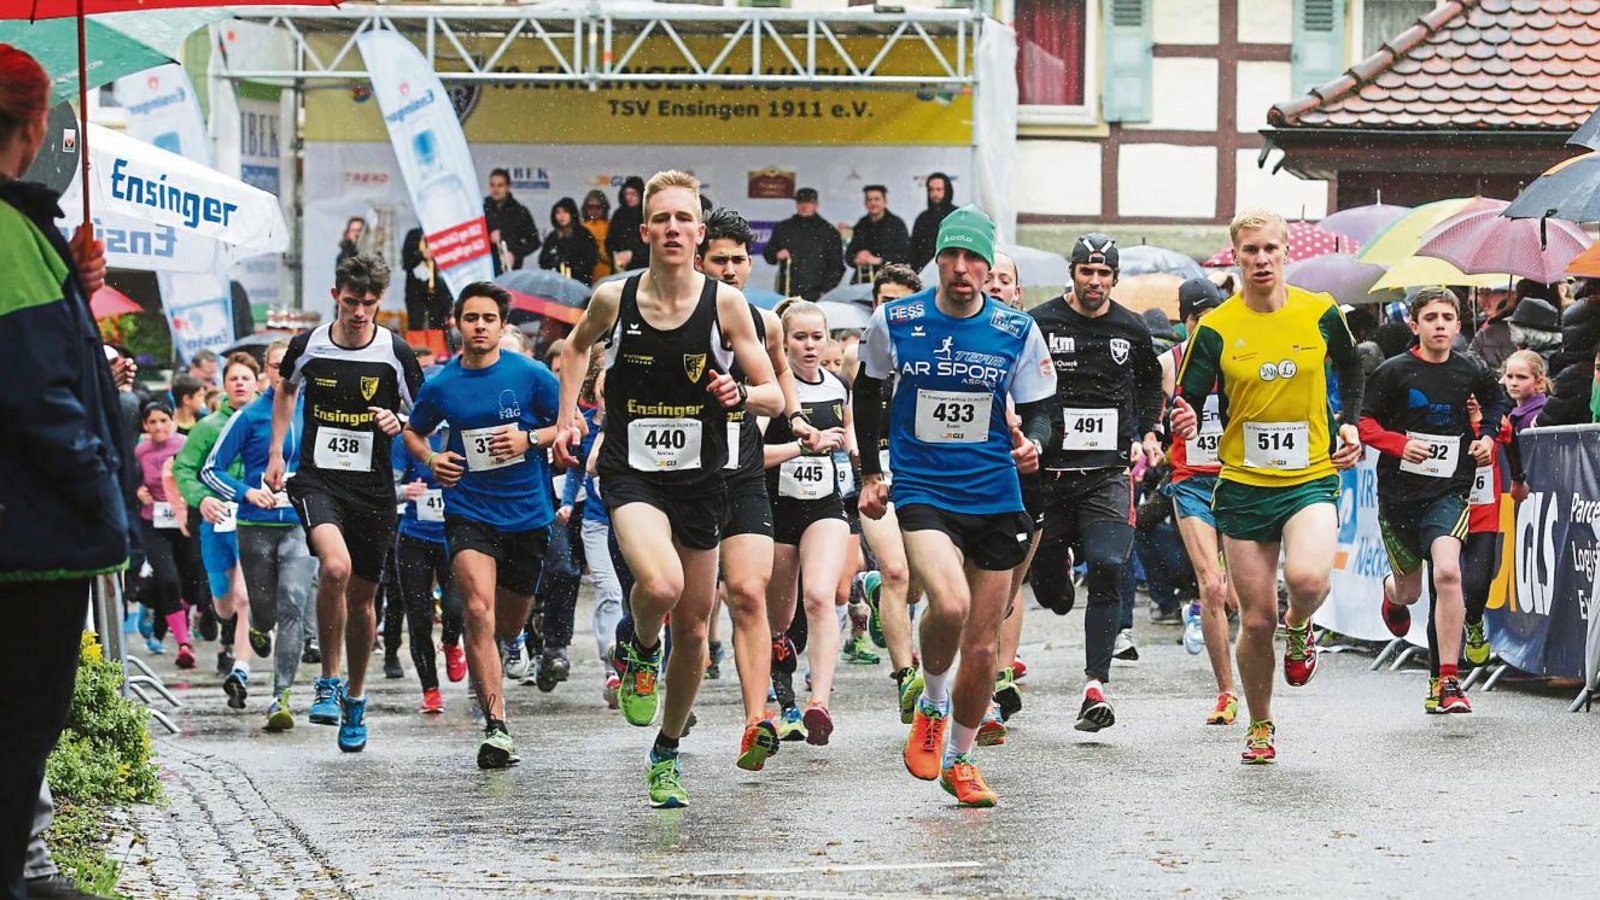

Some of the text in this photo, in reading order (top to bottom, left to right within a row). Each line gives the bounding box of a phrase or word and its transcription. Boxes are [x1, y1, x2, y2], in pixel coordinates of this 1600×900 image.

[608, 99, 873, 120] TSV Ensingen 1911 e.V.
[112, 158, 238, 229] Ensinger
[889, 304, 924, 320] HESS
[1049, 333, 1075, 351] km
[902, 361, 1007, 381] AR SPORT
[314, 404, 376, 427] Ensinger
[627, 399, 704, 420] Ensinger
[933, 403, 975, 423] 433
[1074, 418, 1103, 433] 491
[328, 438, 359, 454] 438
[645, 429, 686, 449] 440
[1258, 433, 1294, 450] 514
[793, 466, 823, 482] 445
[1515, 492, 1559, 616] GLS
